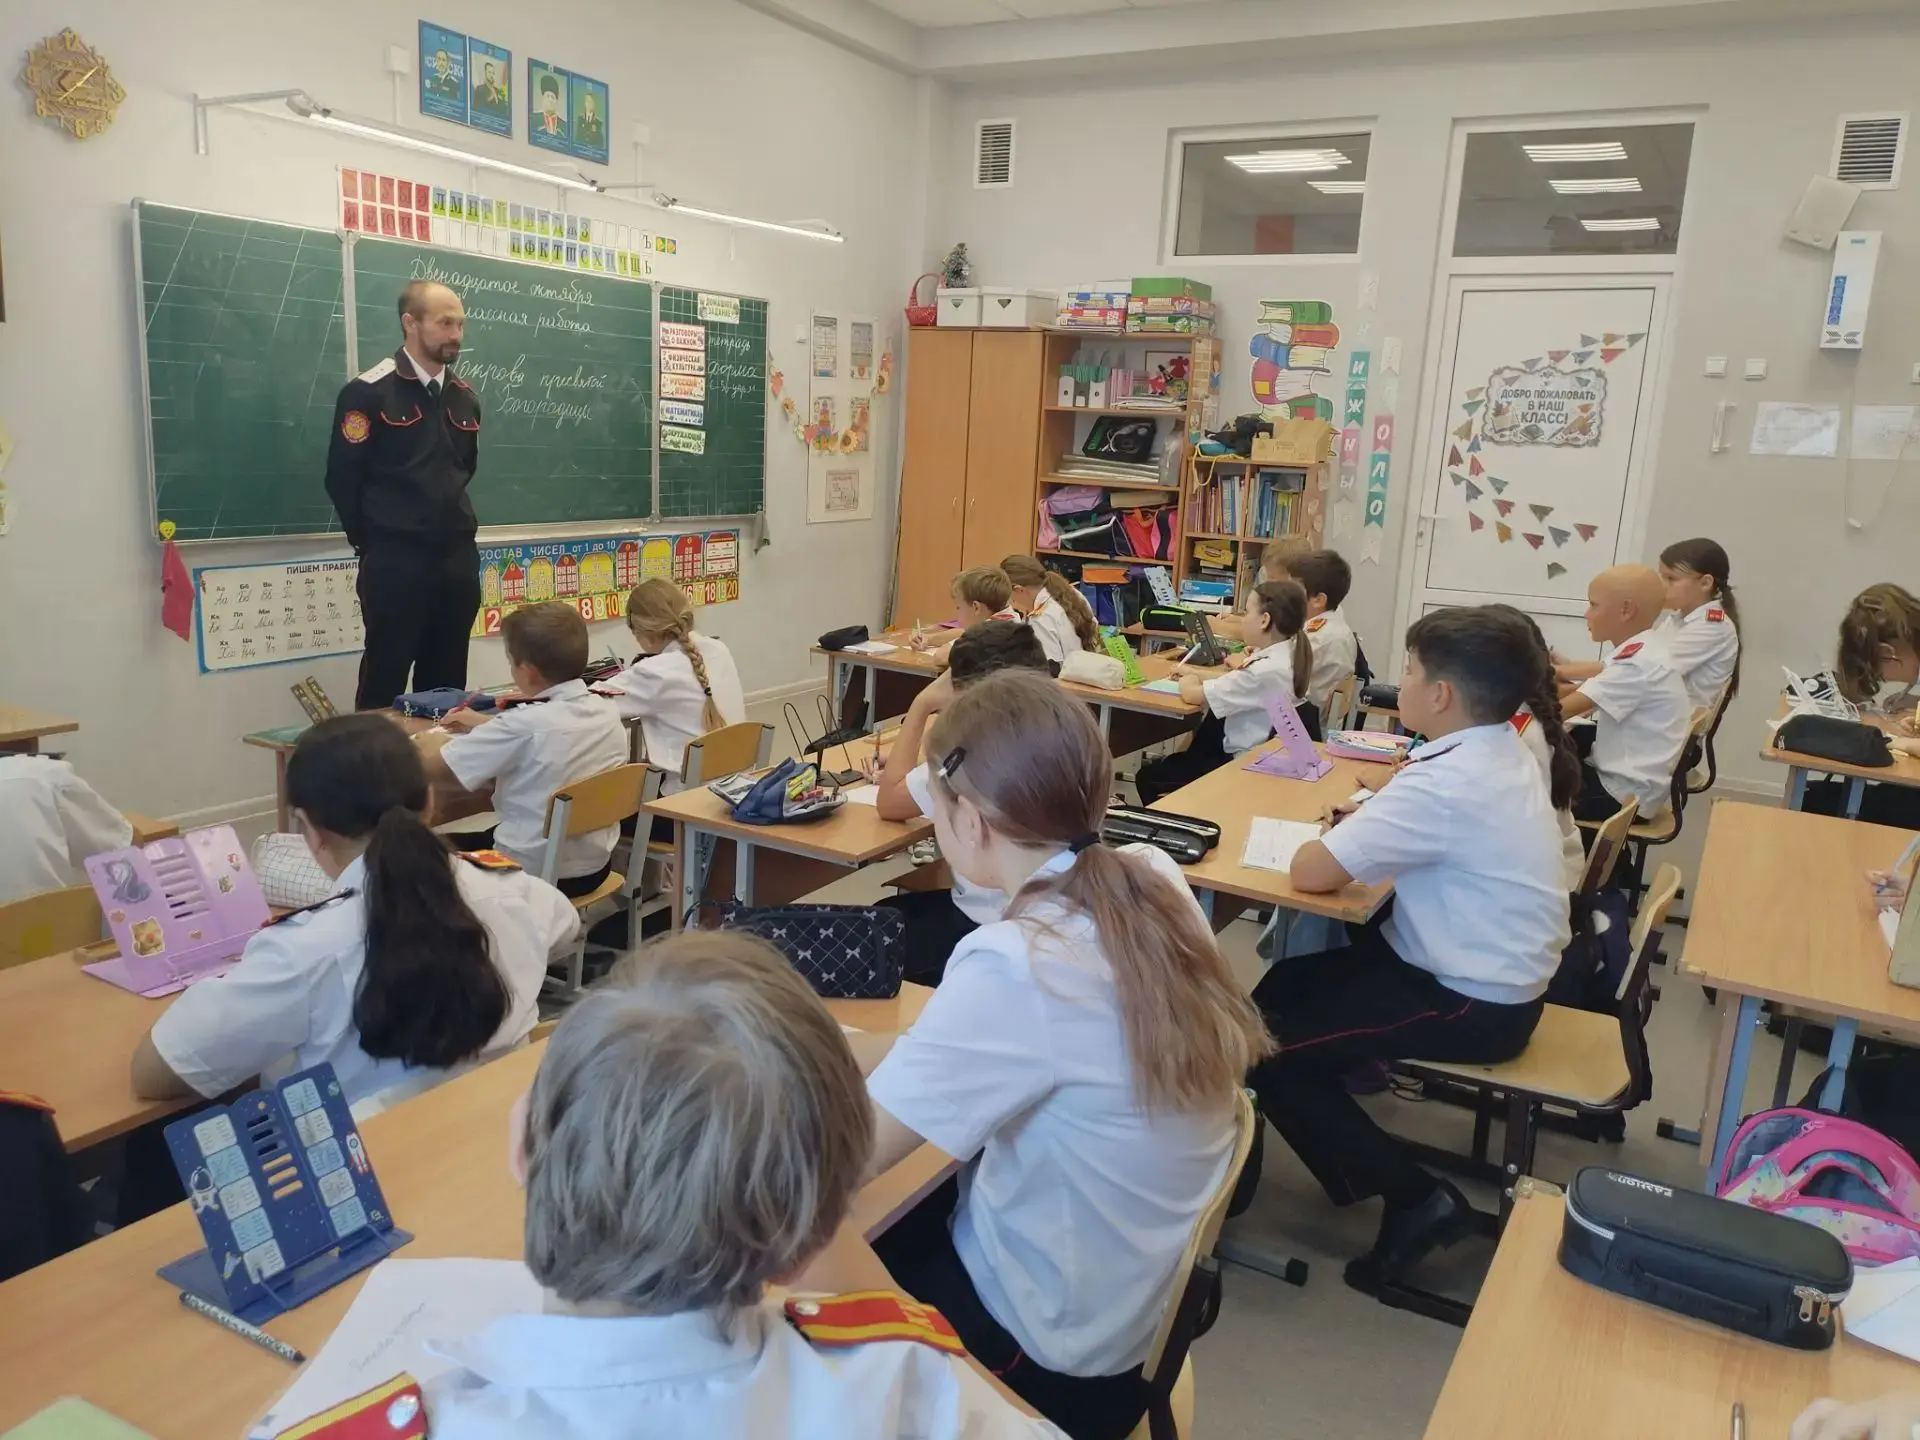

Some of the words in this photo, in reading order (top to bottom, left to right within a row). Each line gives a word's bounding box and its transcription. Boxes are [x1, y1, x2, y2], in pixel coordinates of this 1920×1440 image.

[409, 255, 521, 299] Двенадцатое
[530, 279, 595, 312] октября
[537, 308, 593, 338] работа
[669, 327, 698, 337] РАЗГОВОРЫ
[676, 338, 697, 346] ВАЖНОМ
[709, 335, 751, 356] тетрадь
[668, 354, 700, 363] ФИЗИЧЕСКАЯ
[1501, 389, 1532, 399] ДОБРО
[1533, 389, 1596, 401] ПОЖАЛОВАТЬ
[1528, 401, 1534, 410] В
[1538, 401, 1565, 411] НАШ
[666, 407, 702, 418] МАТЕМАТИКА
[1520, 412, 1568, 424] КЛАСС!
[479, 547, 522, 561] СОСТАВ
[530, 544, 565, 556] ЧИСЕЛ
[572, 545, 581, 553] от
[592, 543, 604, 552] до
[607, 540, 616, 550] 10
[286, 564, 320, 575] ПИШЕМ
[322, 562, 358, 571] ПРАВИЛ
[487, 609, 500, 633] 2
[581, 598, 593, 620] 8
[594, 596, 605, 617] 9
[606, 594, 619, 616] 10
[705, 582, 716, 602] 18
[717, 580, 727, 600] 19
[727, 579, 738, 599] 20
